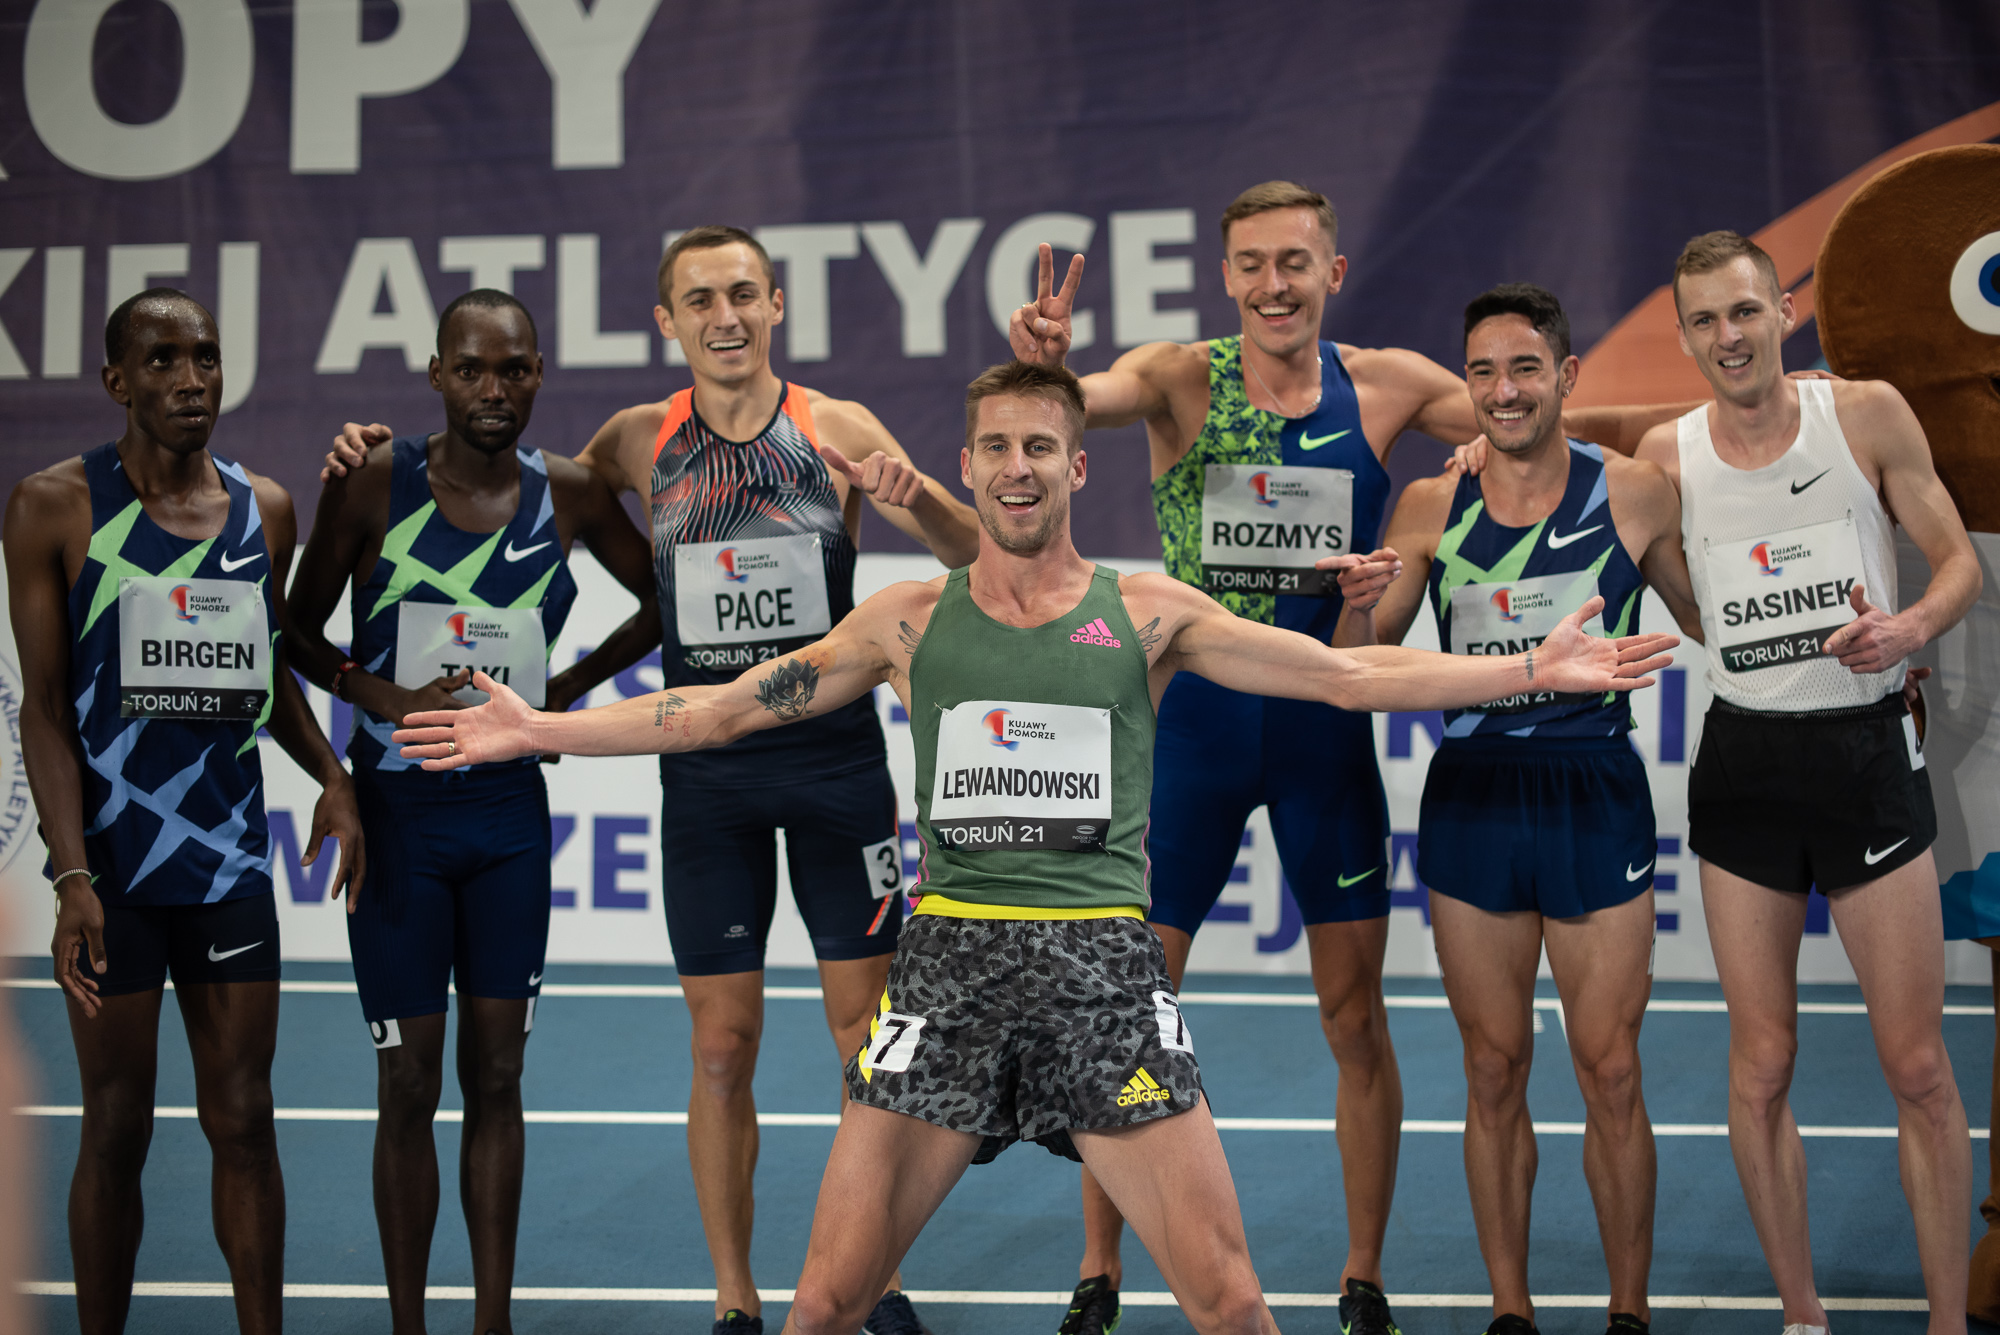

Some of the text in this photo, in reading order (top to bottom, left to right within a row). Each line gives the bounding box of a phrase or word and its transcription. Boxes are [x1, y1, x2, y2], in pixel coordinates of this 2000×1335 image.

[0, 0, 662, 181] OPY
[315, 209, 1197, 375] ATLTYCE
[1269, 489, 1310, 498] POMORZE
[1270, 481, 1302, 490] KUJAWY
[1211, 521, 1343, 550] ROZMYS
[737, 554, 771, 563] KUJAWY
[1770, 544, 1804, 557] KUJAWY
[1771, 549, 1812, 564] POMORZE
[738, 561, 780, 571] POMORZE
[1209, 569, 1299, 589] TORUŃ 21
[189, 595, 223, 604] KUJAWY
[1512, 592, 1545, 603] KUJAWY
[1513, 599, 1554, 611] POMORZE
[1722, 576, 1856, 627] SASINEK
[189, 603, 231, 613] POMORZE
[715, 587, 796, 632] PACE
[467, 630, 510, 639] POMORZE
[468, 622, 503, 631] KUJAWY
[1069, 631, 1122, 649] adidas
[141, 639, 255, 670] BIRGEN
[691, 645, 780, 667] TORUŃ 21
[1729, 636, 1819, 668] TORUŃ 21
[130, 691, 198, 712] TORUŃ
[202, 696, 221, 712] 21
[1008, 719, 1048, 731] KUJAWY
[1008, 728, 1056, 741] POMORZE
[942, 767, 1100, 800] LEWANDOWSKI
[940, 820, 1045, 845] TORUŃ 21
[876, 844, 901, 890] 3
[1162, 997, 1184, 1046] 7
[873, 1018, 912, 1065] 7
[1116, 1086, 1170, 1107] adidas
